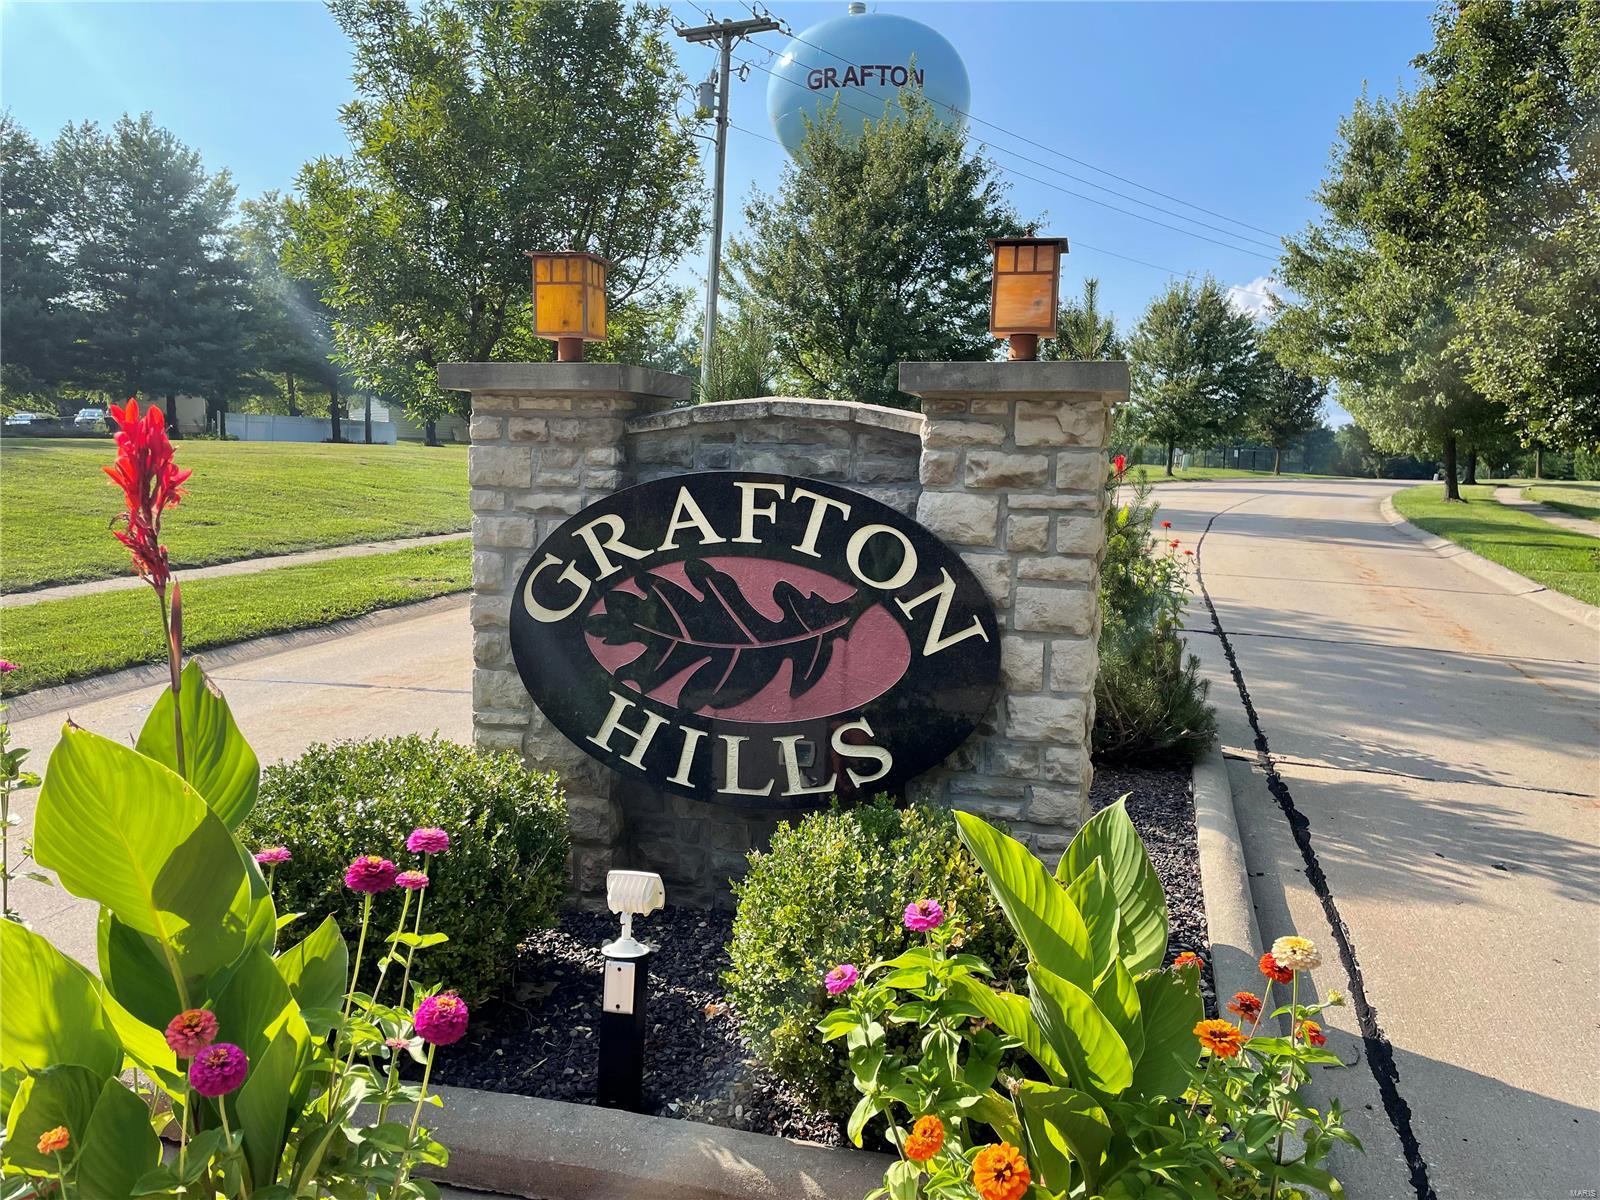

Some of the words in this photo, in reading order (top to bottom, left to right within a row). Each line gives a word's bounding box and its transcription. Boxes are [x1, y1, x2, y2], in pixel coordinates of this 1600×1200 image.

[807, 65, 924, 90] GRAFTON
[523, 481, 990, 657] GRAFTON
[586, 691, 893, 797] HILLS
